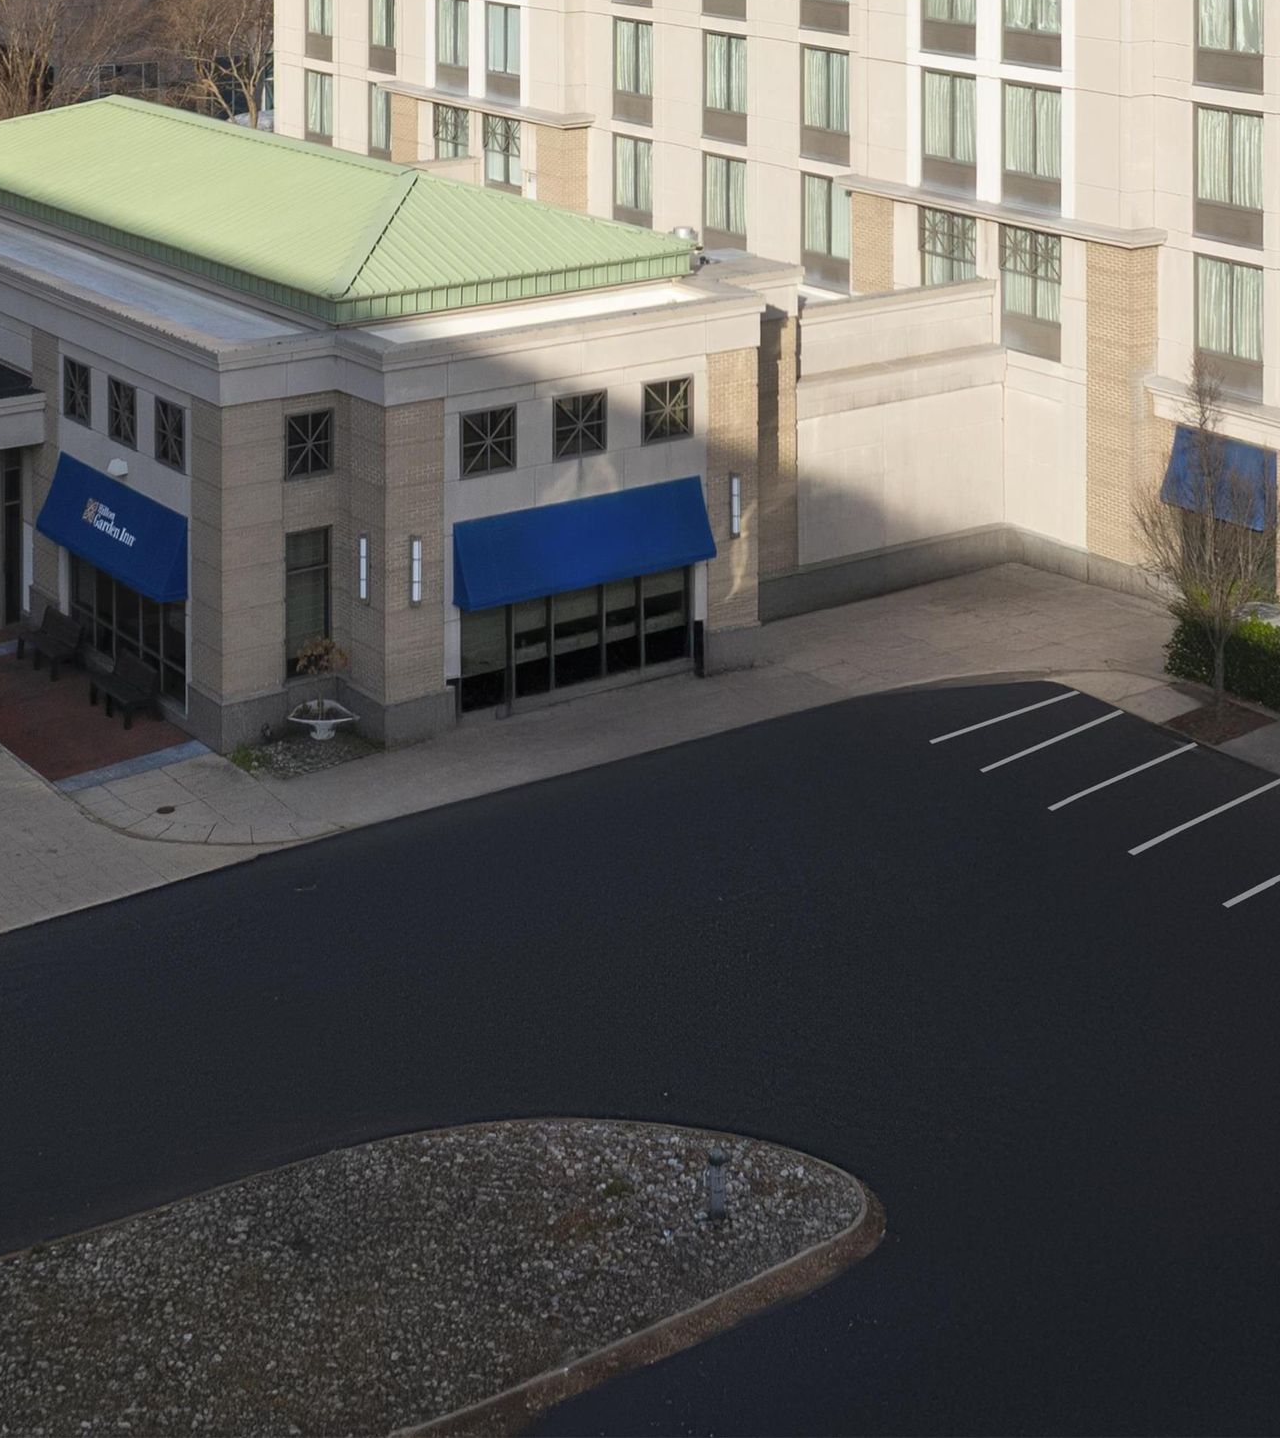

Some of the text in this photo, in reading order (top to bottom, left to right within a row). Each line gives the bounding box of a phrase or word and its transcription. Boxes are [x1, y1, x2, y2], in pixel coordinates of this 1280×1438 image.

[97, 503, 116, 520] Hilton
[93, 513, 135, 547] Garden Inn
